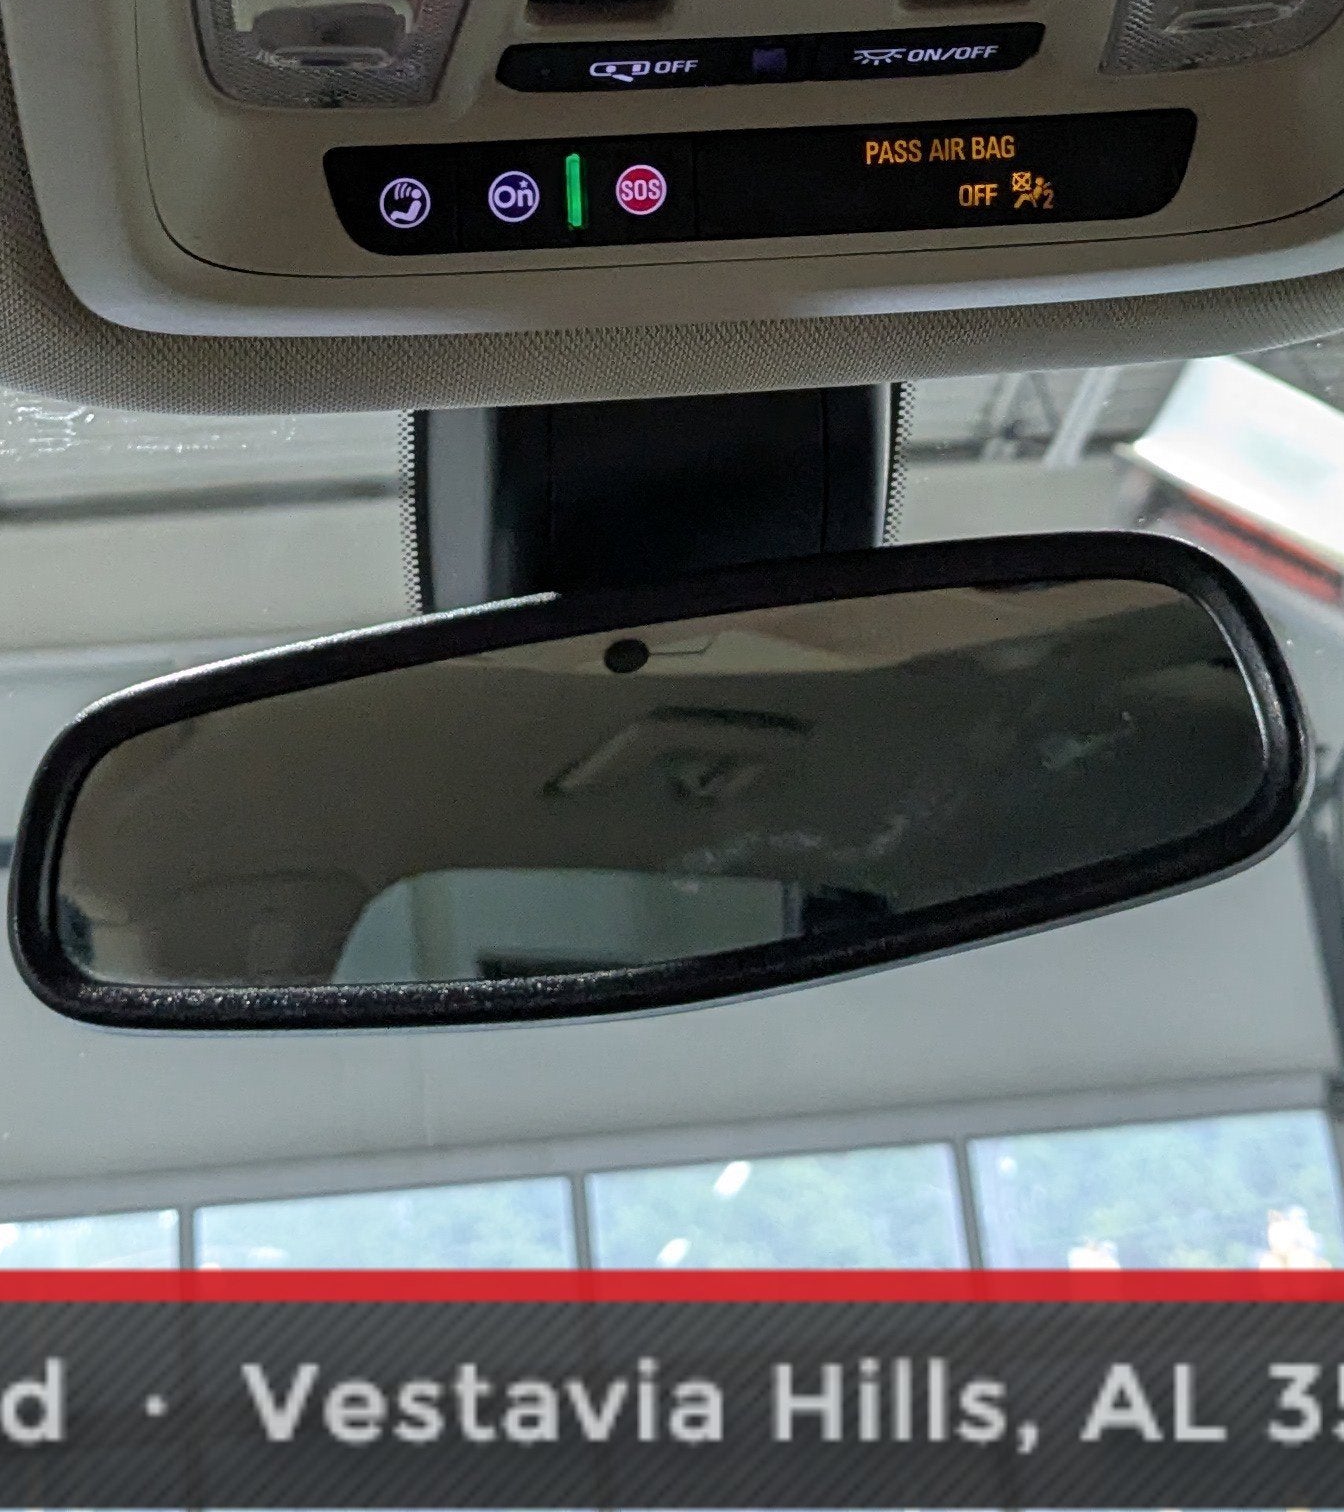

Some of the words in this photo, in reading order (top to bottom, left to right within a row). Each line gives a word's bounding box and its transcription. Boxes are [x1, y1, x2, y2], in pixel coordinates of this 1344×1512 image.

[907, 45, 999, 63] ON/OFF
[654, 59, 699, 74] OFF
[865, 139, 923, 165] PASS
[928, 137, 966, 162] AIR
[971, 135, 1016, 160] BAG
[620, 178, 662, 202] SOS
[958, 183, 999, 207] OFF
